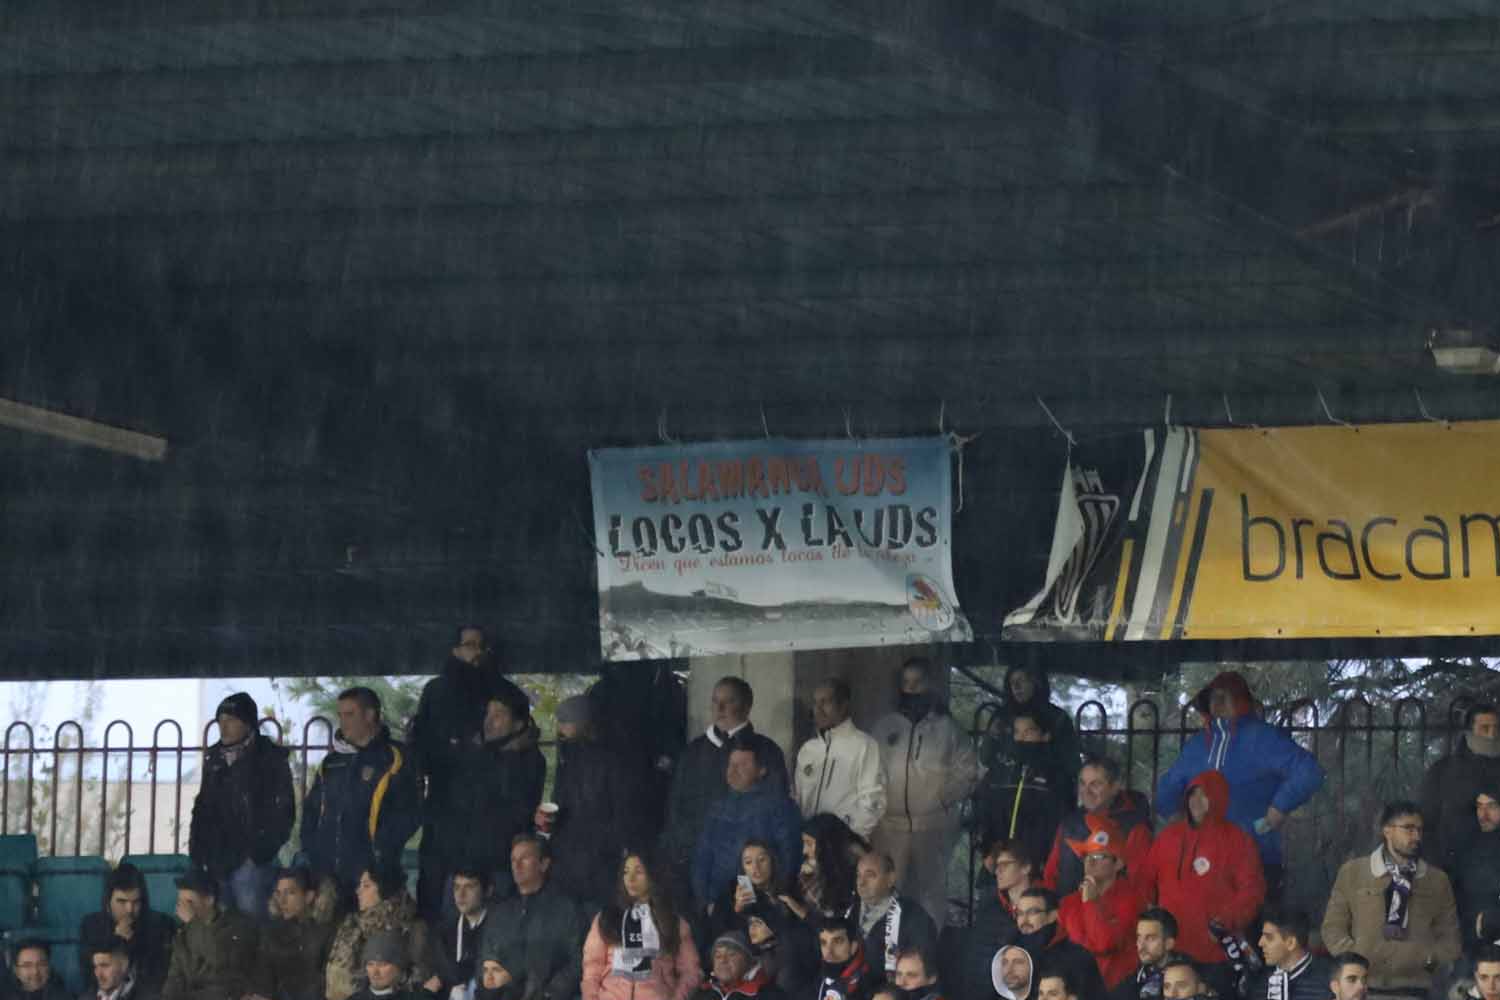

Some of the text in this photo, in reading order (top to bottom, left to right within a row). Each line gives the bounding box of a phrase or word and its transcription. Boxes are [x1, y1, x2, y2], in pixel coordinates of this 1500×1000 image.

[834, 452, 908, 497] UDS
[608, 510, 744, 558] LOCOS
[756, 506, 787, 550] X
[673, 558, 701, 576] que
